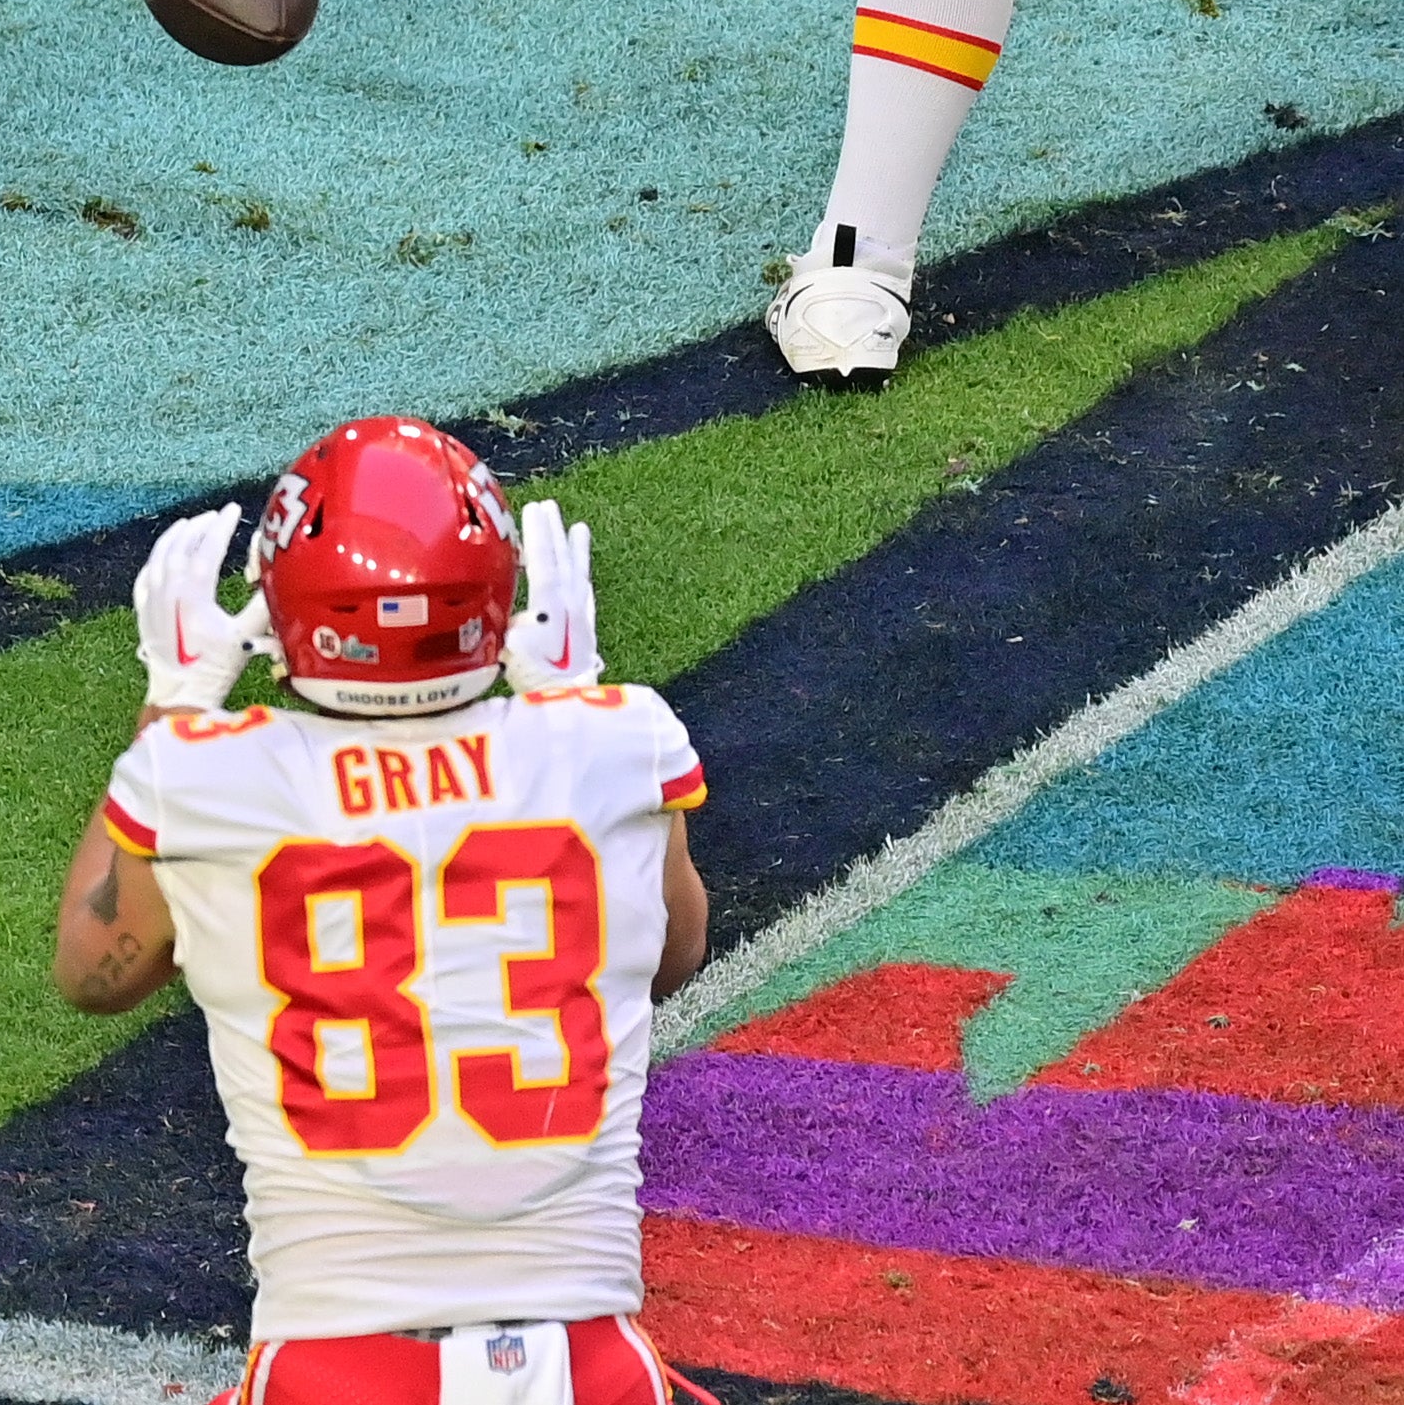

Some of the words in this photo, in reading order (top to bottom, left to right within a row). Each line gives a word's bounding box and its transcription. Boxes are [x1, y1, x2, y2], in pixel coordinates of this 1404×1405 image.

[336, 690, 409, 705] CHOOSE
[416, 685, 460, 704] LOVE
[332, 734, 496, 817] GRAY
[253, 818, 611, 1158] 83
